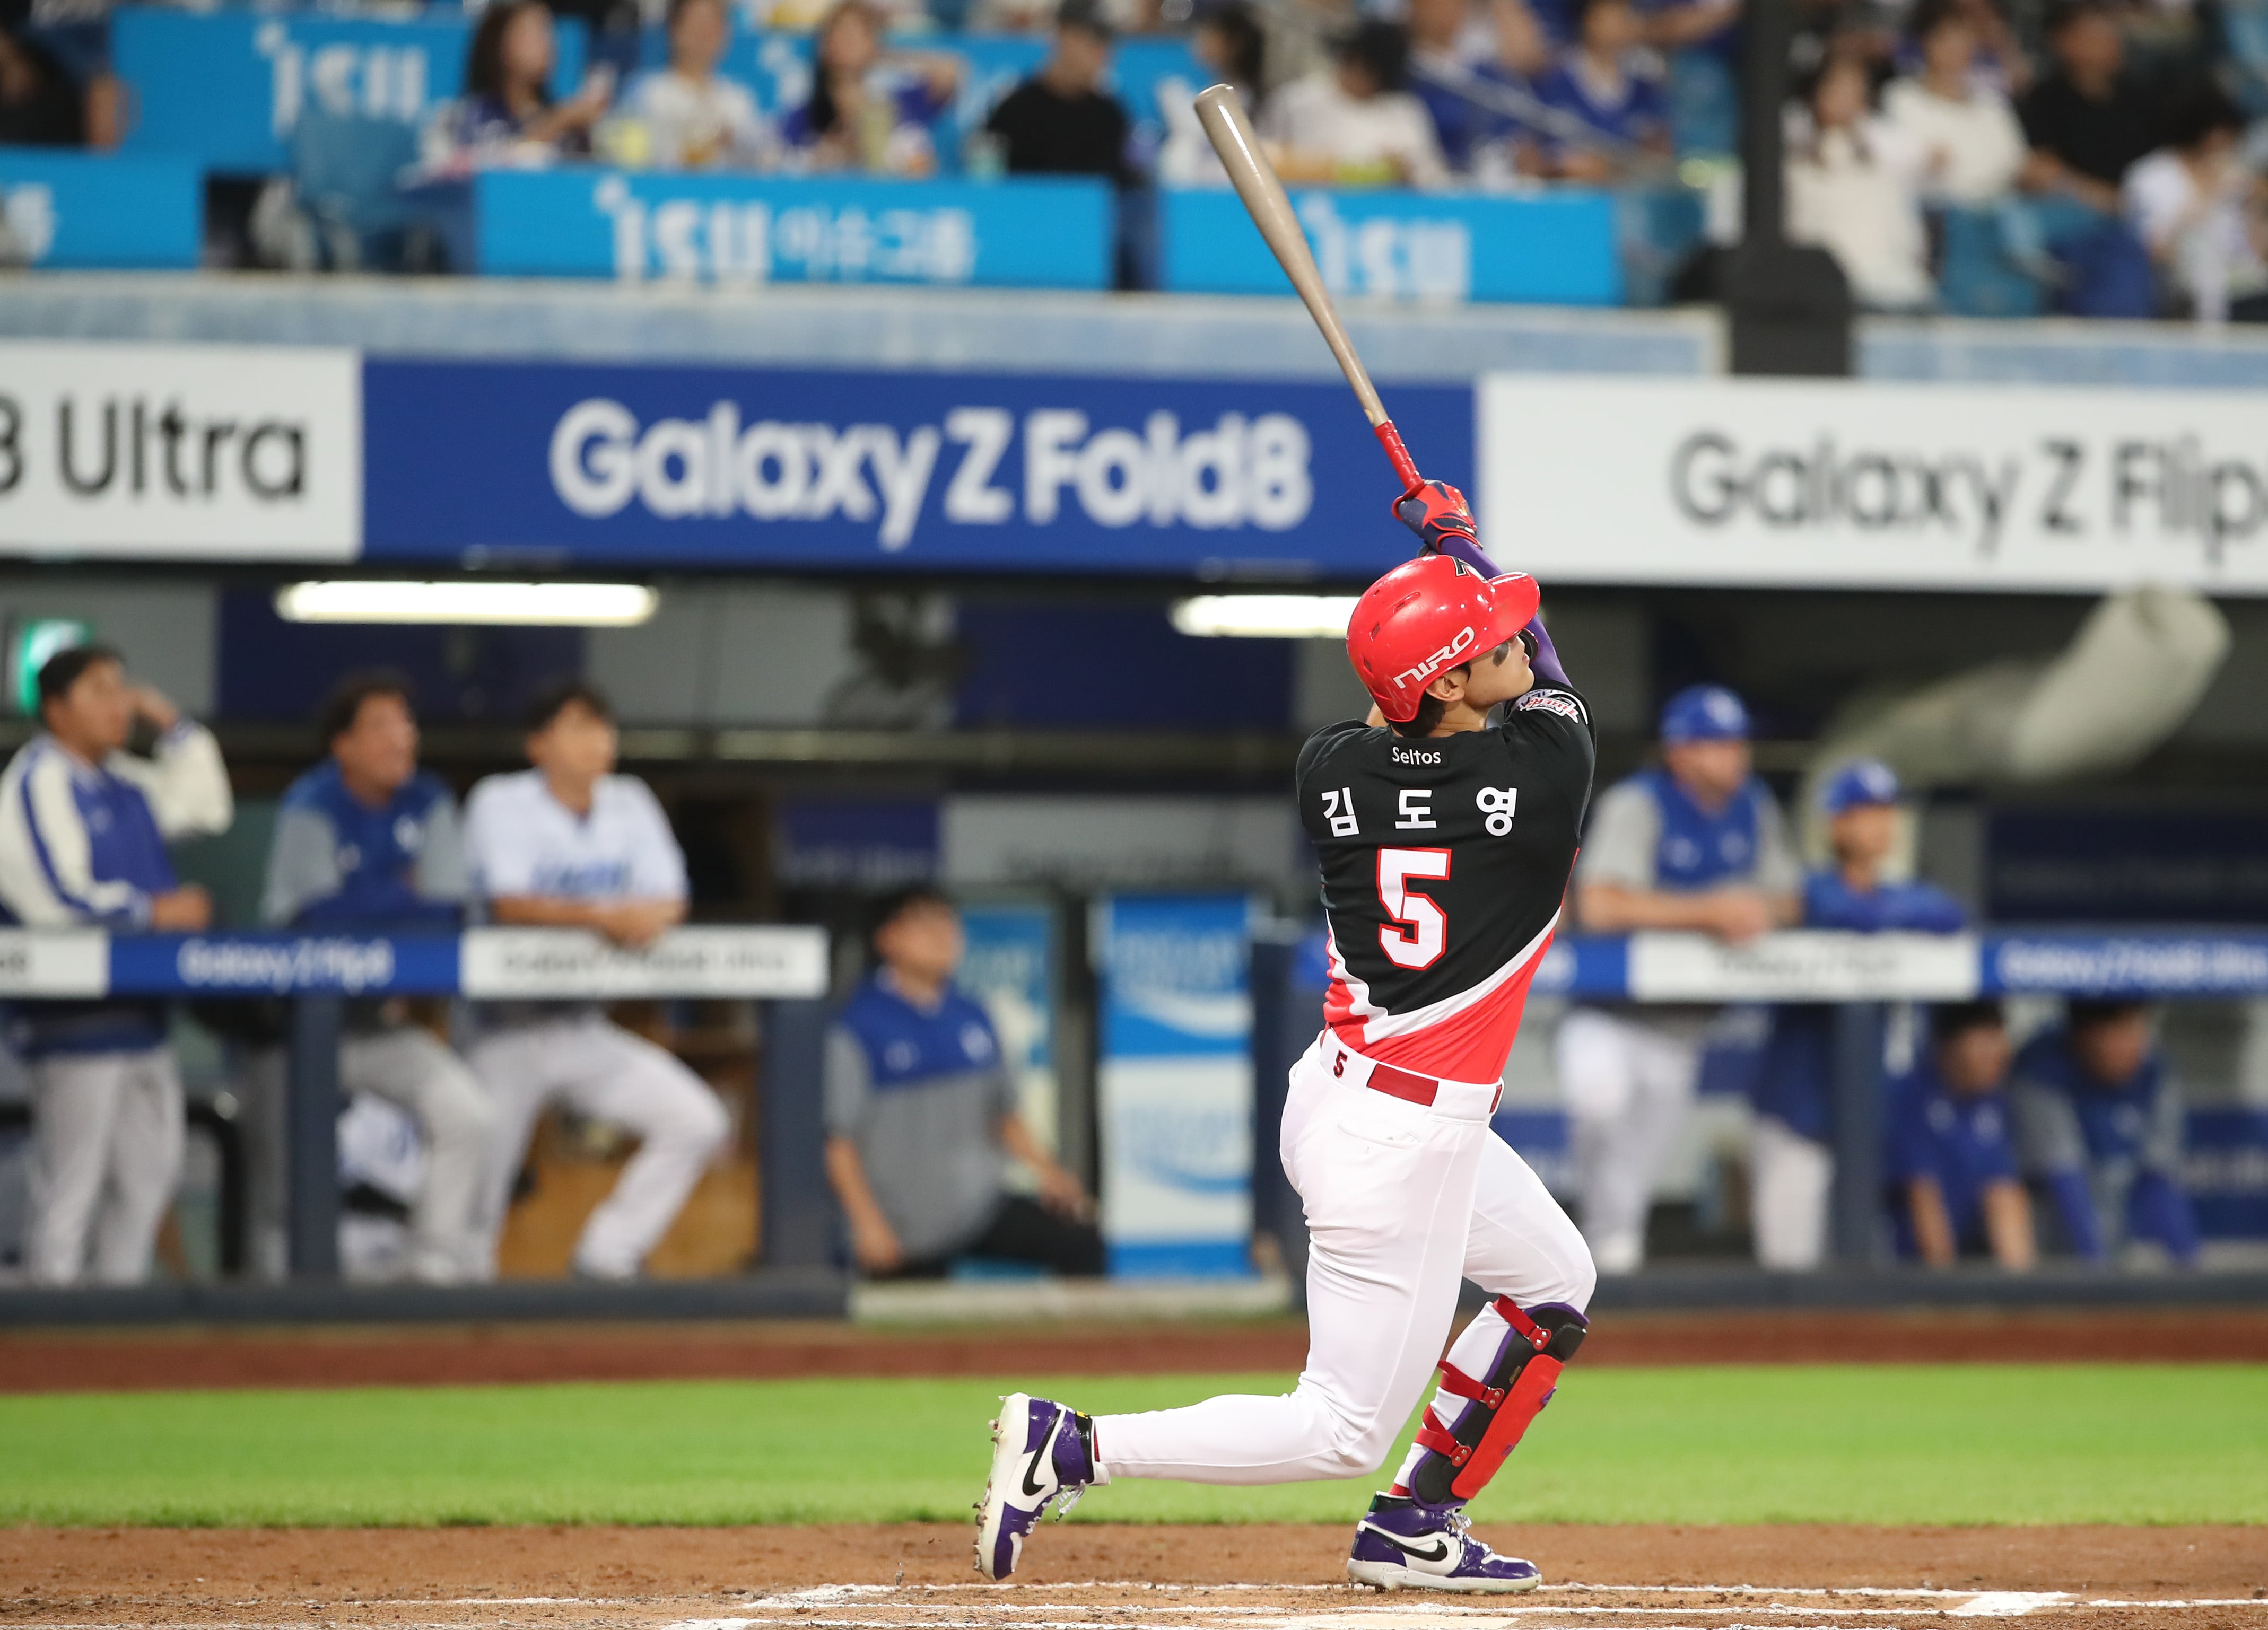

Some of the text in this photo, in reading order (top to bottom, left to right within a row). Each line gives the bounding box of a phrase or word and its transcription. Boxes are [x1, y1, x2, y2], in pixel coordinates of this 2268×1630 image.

[56, 393, 307, 503] Ultra
[550, 399, 1312, 550] Galaxy Z Fold8
[1671, 430, 2020, 558] Galaxy
[2040, 438, 2086, 535] Z
[1392, 746, 1442, 765] Seltos
[1376, 845, 1452, 971] 5
[1333, 1049, 1348, 1079] 5
